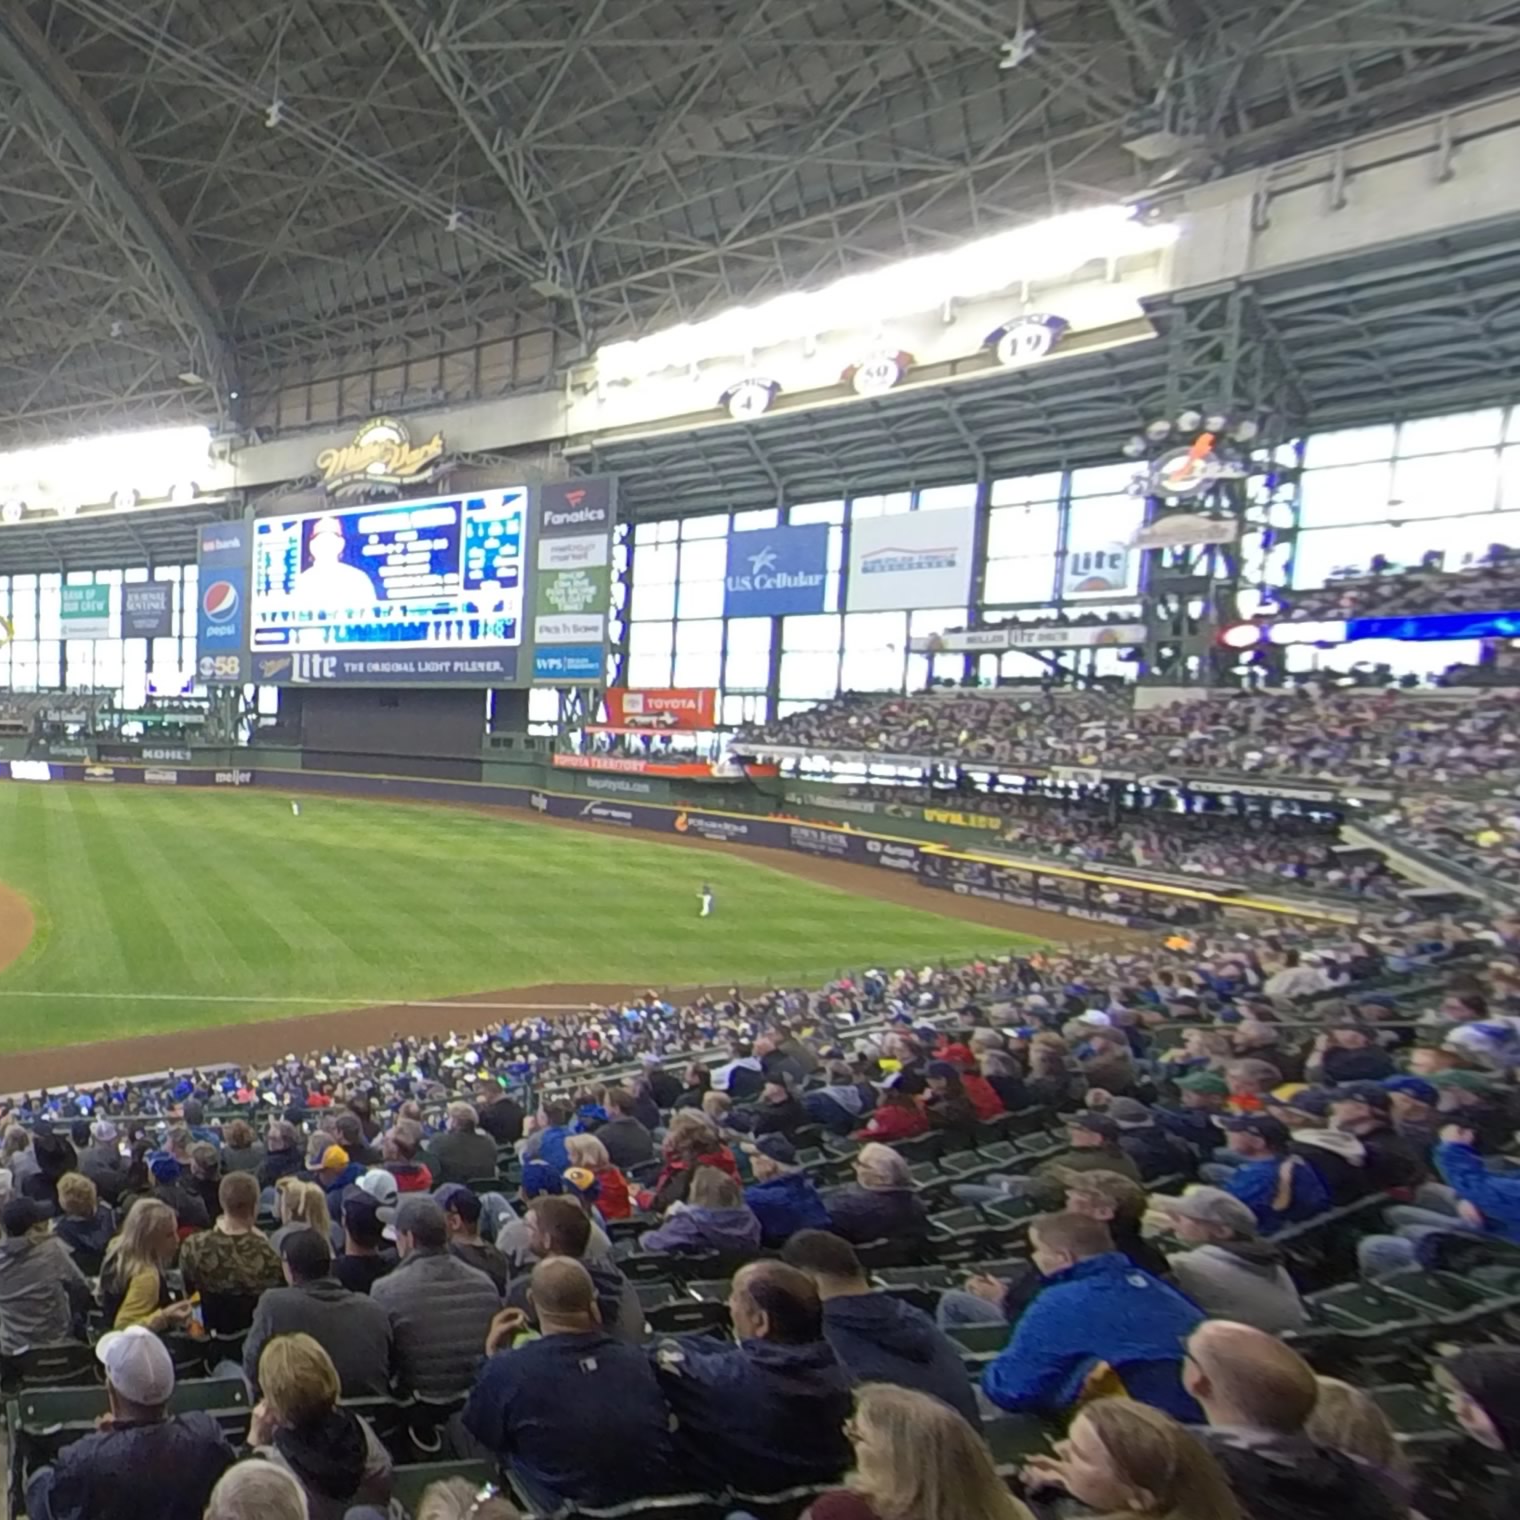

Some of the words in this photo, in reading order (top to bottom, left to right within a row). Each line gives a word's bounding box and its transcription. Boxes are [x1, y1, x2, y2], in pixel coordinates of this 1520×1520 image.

[543, 507, 606, 527] Fanatics
[1071, 551, 1122, 577] Lite
[754, 571, 825, 590] Cellular
[206, 624, 236, 638] pepsi
[215, 656, 240, 676] 58
[291, 653, 337, 683] Lite
[344, 662, 364, 673] THE
[418, 661, 451, 673] LIGHT
[647, 698, 696, 709] TOYOTA
[215, 769, 252, 786] meijer
